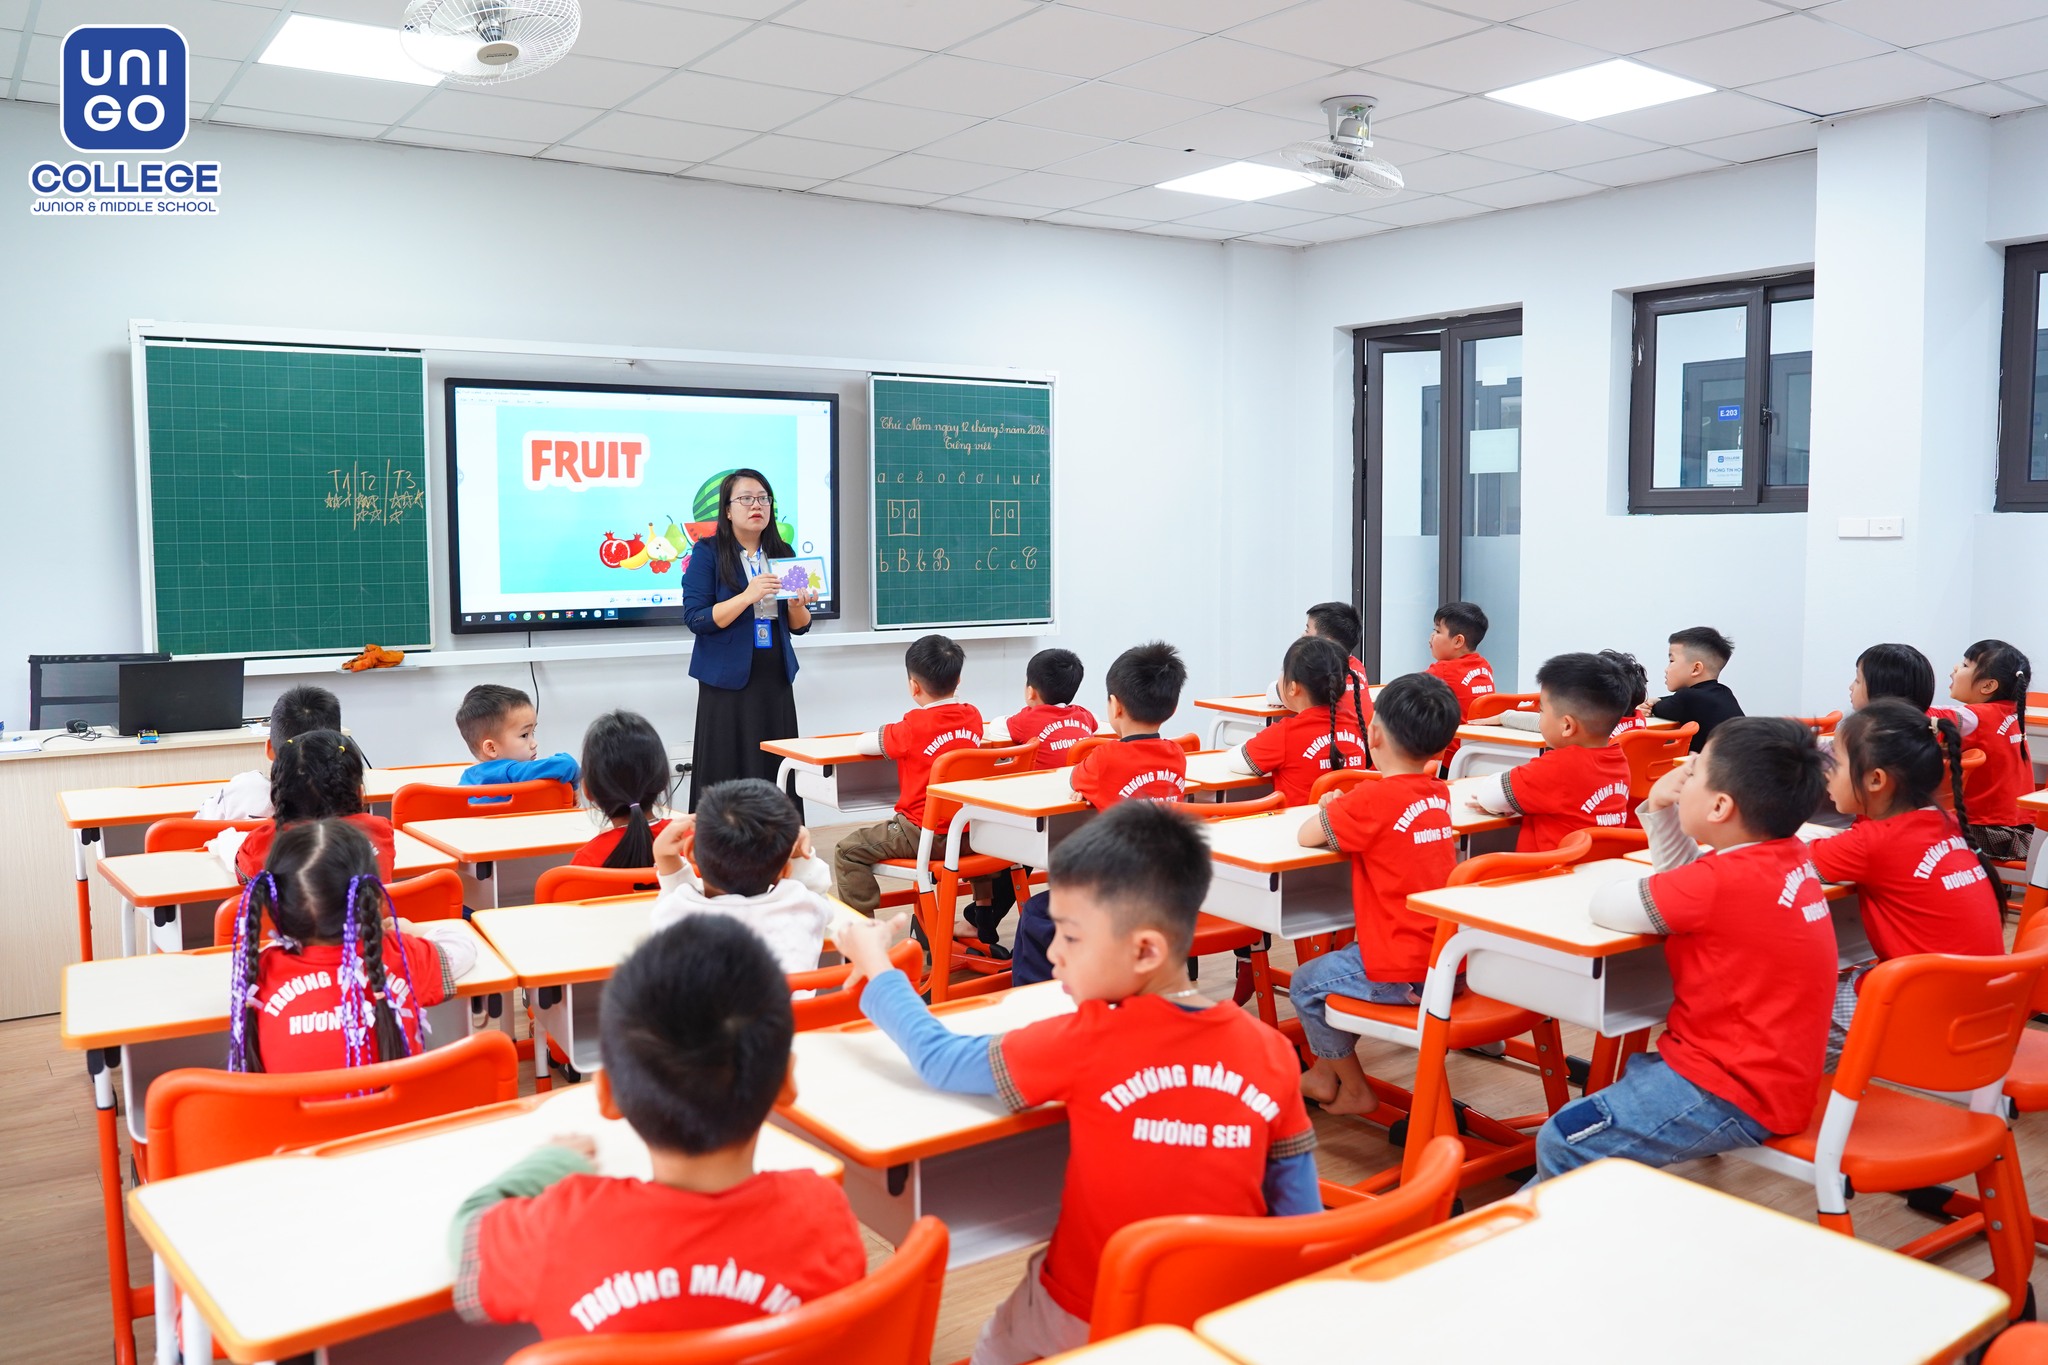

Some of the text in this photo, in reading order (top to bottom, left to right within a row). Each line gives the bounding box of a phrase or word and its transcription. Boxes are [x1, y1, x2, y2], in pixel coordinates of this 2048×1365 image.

[961, 422, 969, 432] 12
[1027, 424, 1045, 435] 2026
[531, 439, 642, 483] FRUIT
[327, 469, 416, 493] T1 T2 T3
[877, 472, 886, 484] a
[897, 472, 905, 484] e
[898, 548, 911, 573] B
[289, 1010, 345, 1035] HƯƠN
[1100, 1063, 1187, 1113] TRƯỜNG
[1240, 1083, 1280, 1122] NON
[1212, 1124, 1251, 1148] SEN
[760, 1283, 802, 1315] NO
